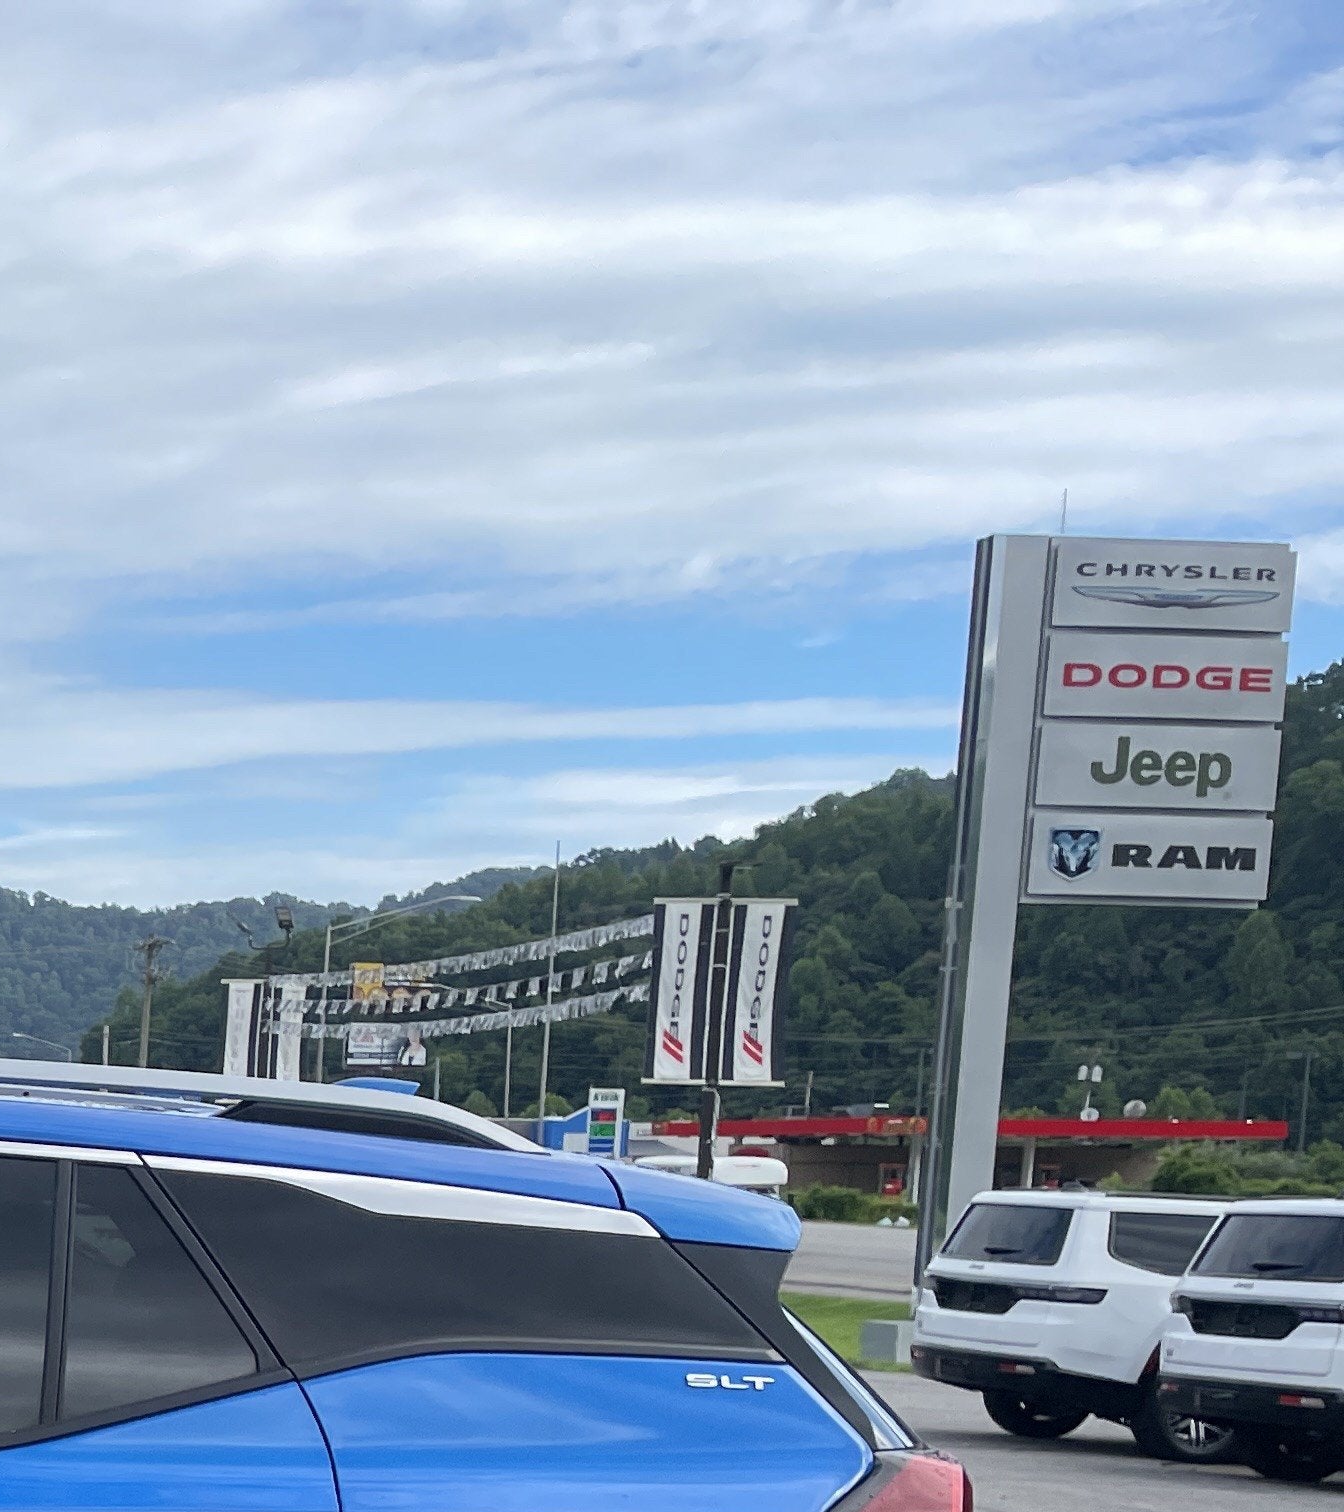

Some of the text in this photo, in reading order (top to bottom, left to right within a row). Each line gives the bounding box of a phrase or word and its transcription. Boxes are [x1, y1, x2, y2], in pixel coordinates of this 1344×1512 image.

[1075, 562, 1277, 583] CHRYSLER
[1062, 662, 1273, 693] DODGE
[1090, 735, 1232, 798] Jeep
[1111, 842, 1257, 872] RAM
[685, 1372, 776, 1391] SLT
